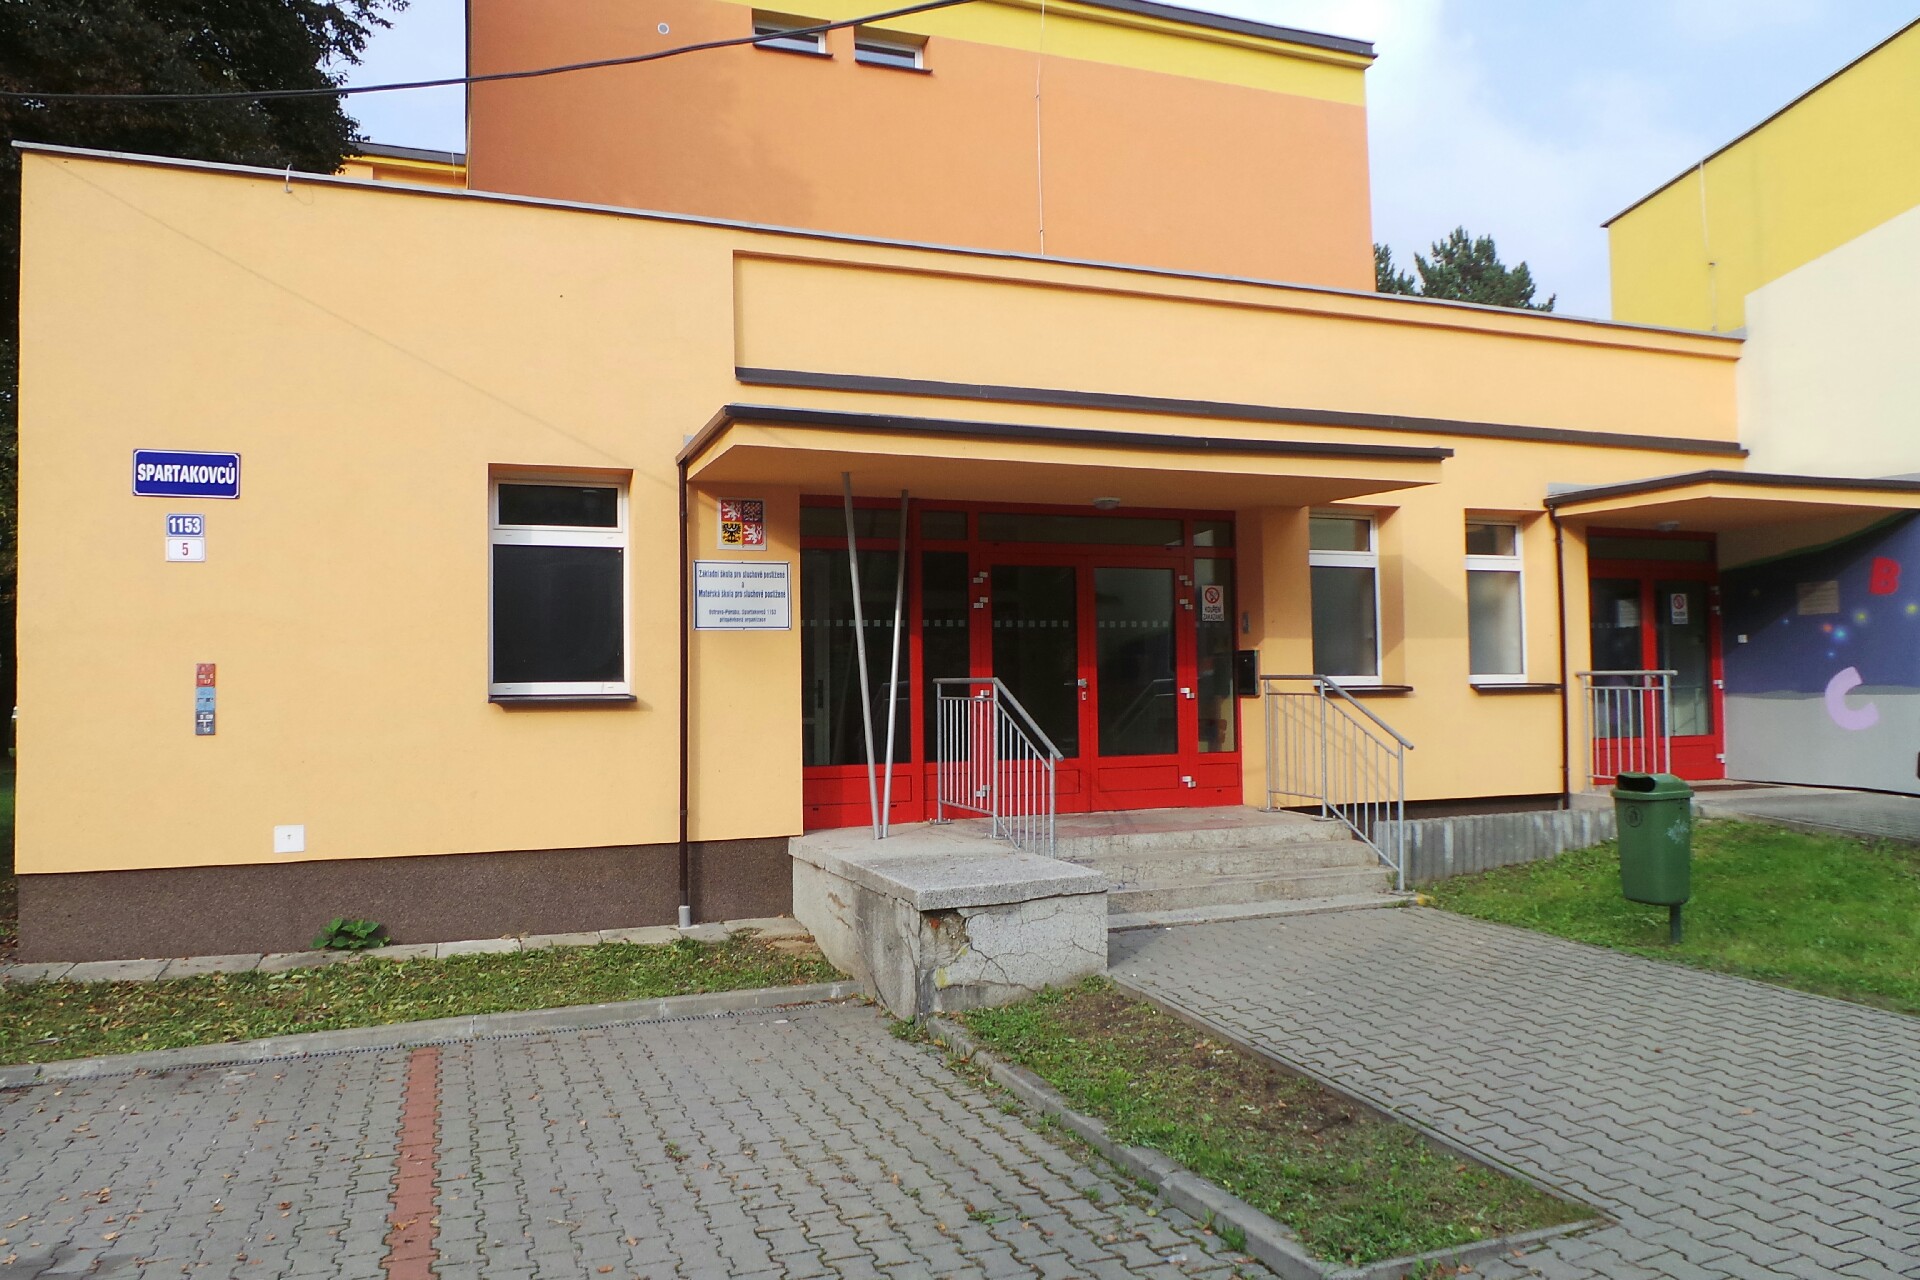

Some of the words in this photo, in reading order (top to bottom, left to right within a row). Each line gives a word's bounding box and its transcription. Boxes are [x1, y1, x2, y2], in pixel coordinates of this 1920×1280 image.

[137, 462, 236, 484] SPARTAKOVCŮ
[169, 517, 201, 533] 1153
[182, 542, 189, 556] 5
[720, 570, 733, 578] škola
[733, 571, 741, 579] pro
[1869, 556, 1902, 595] B
[721, 589, 734, 598] škola
[734, 591, 743, 599] pro
[1824, 665, 1880, 731] C
